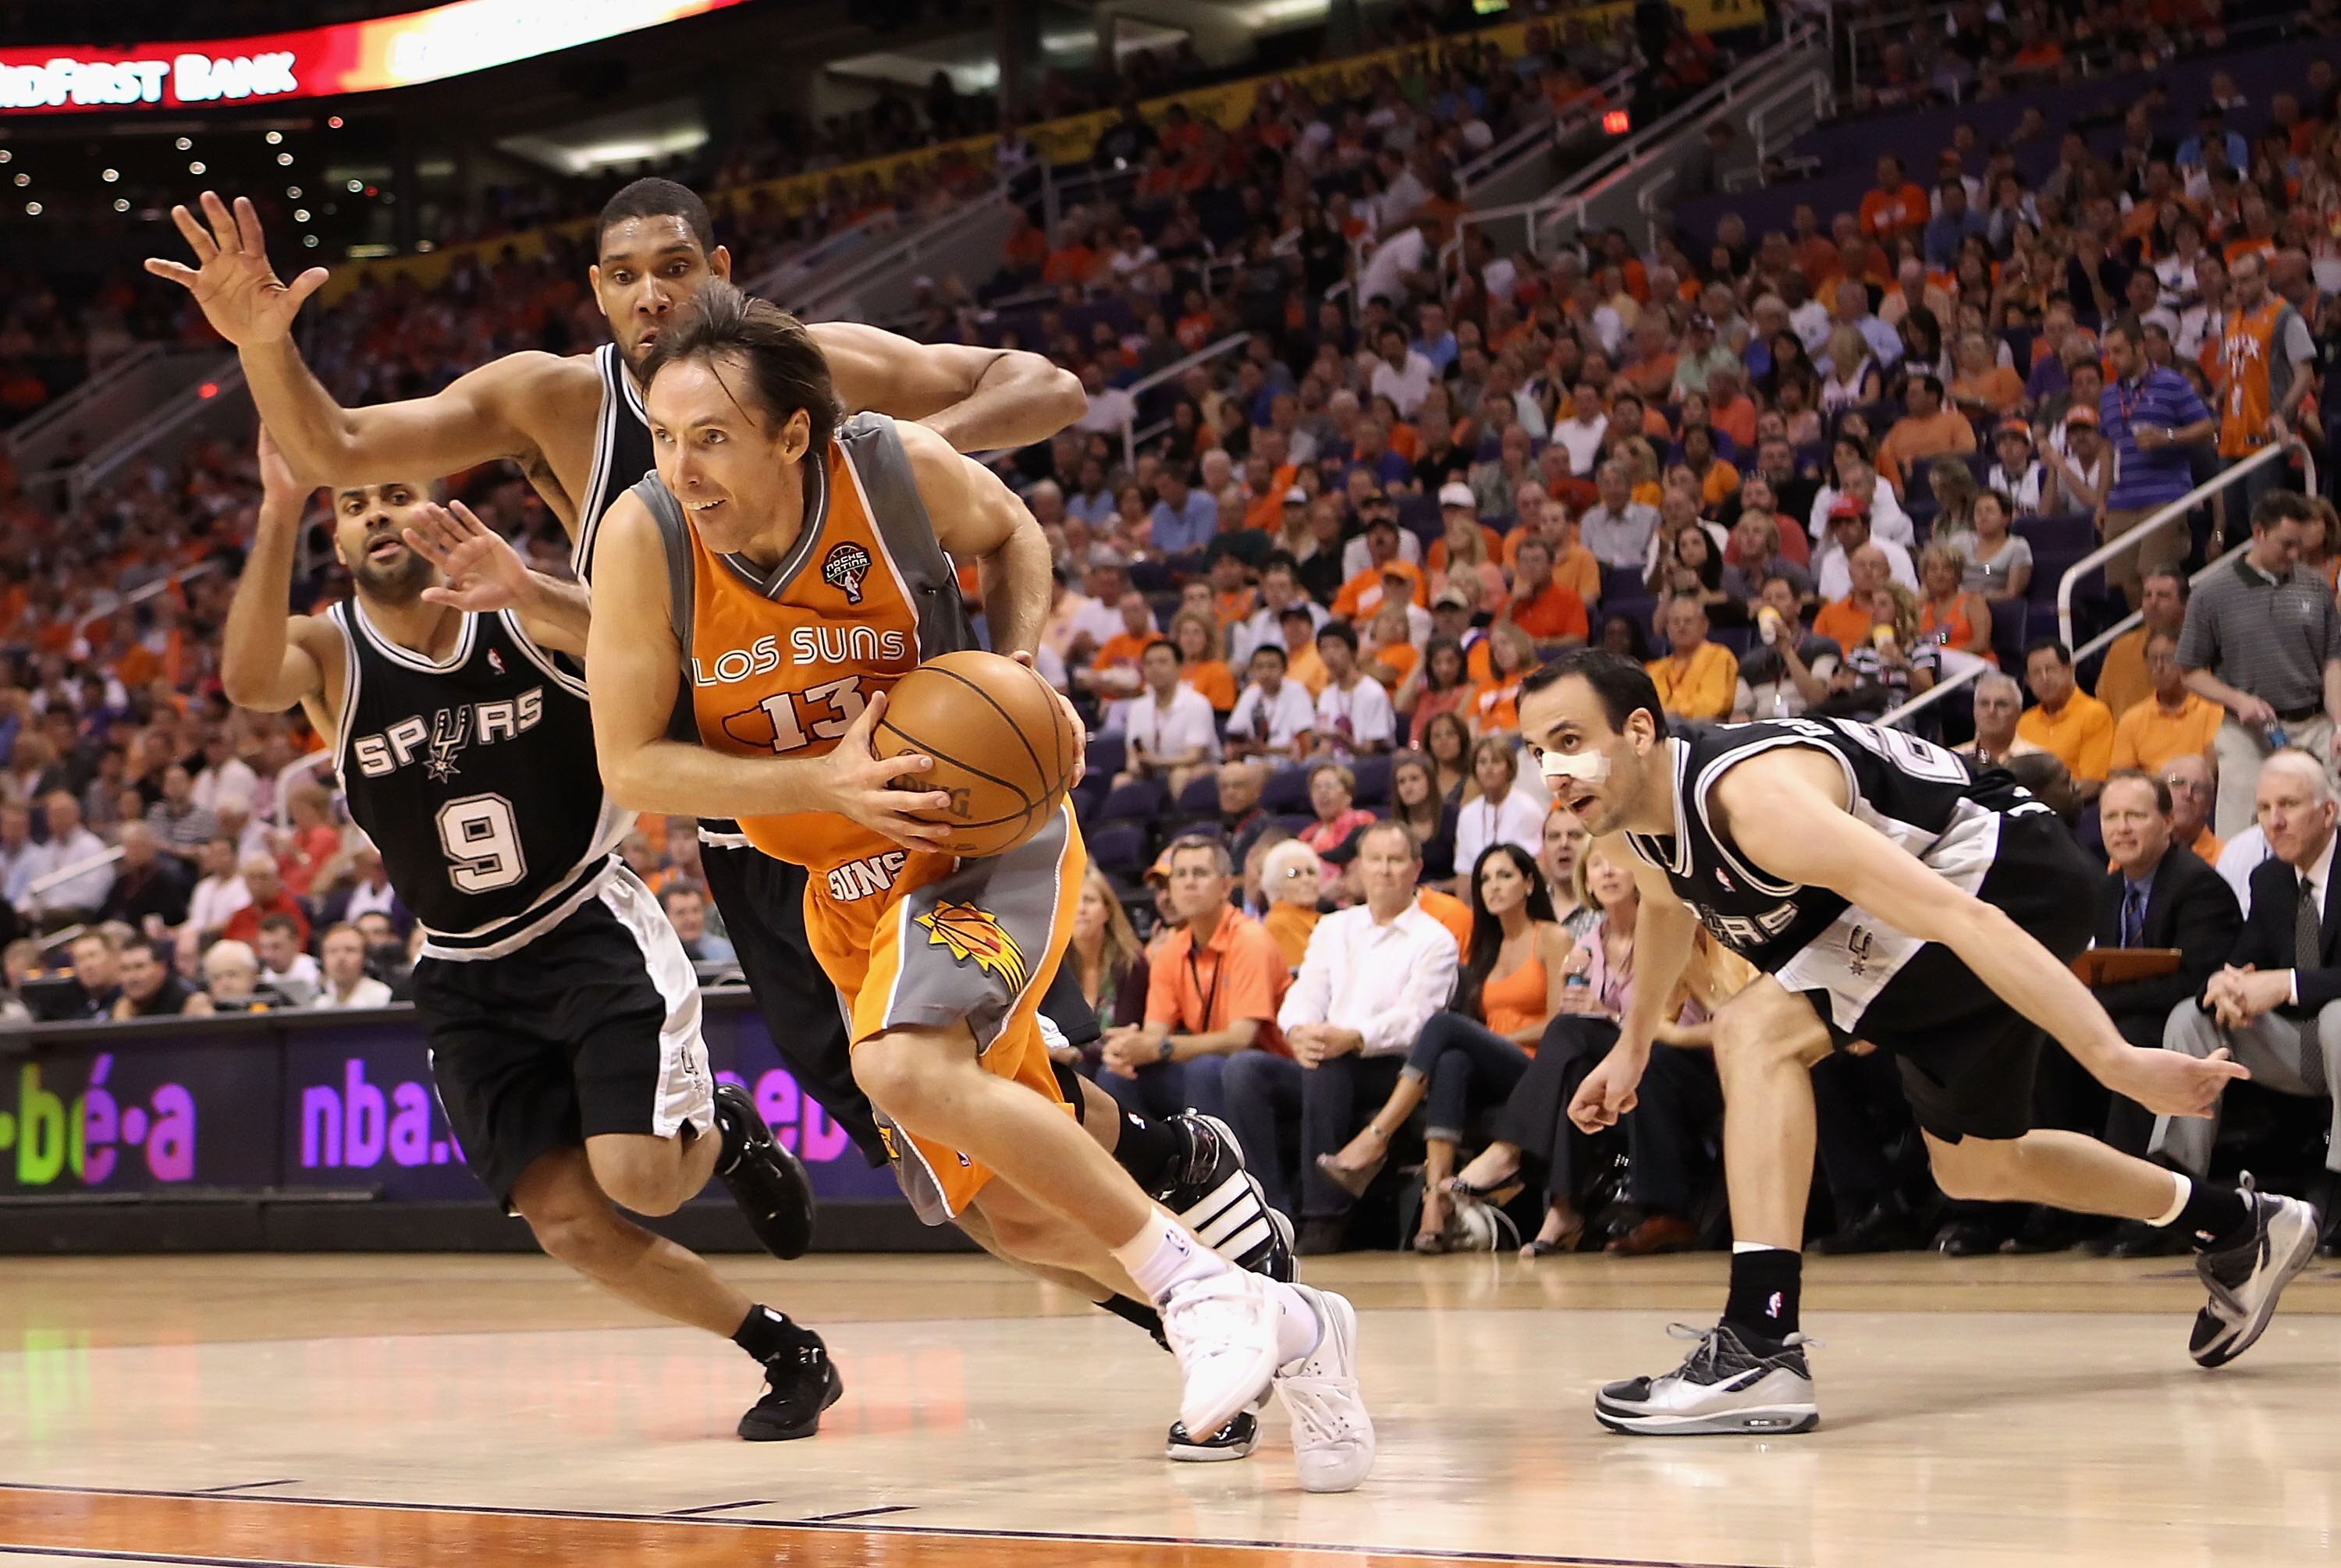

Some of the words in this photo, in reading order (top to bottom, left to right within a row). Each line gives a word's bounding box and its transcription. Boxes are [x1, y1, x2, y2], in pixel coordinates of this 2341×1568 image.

[826, 552, 865, 572] NOCHE
[827, 558, 868, 578] LATINA
[691, 634, 780, 687] LOS
[790, 625, 906, 665] SUNS
[353, 685, 545, 783] SPURS
[759, 675, 868, 754] 13
[435, 791, 528, 896] 9
[301, 1058, 467, 1168] nba.
